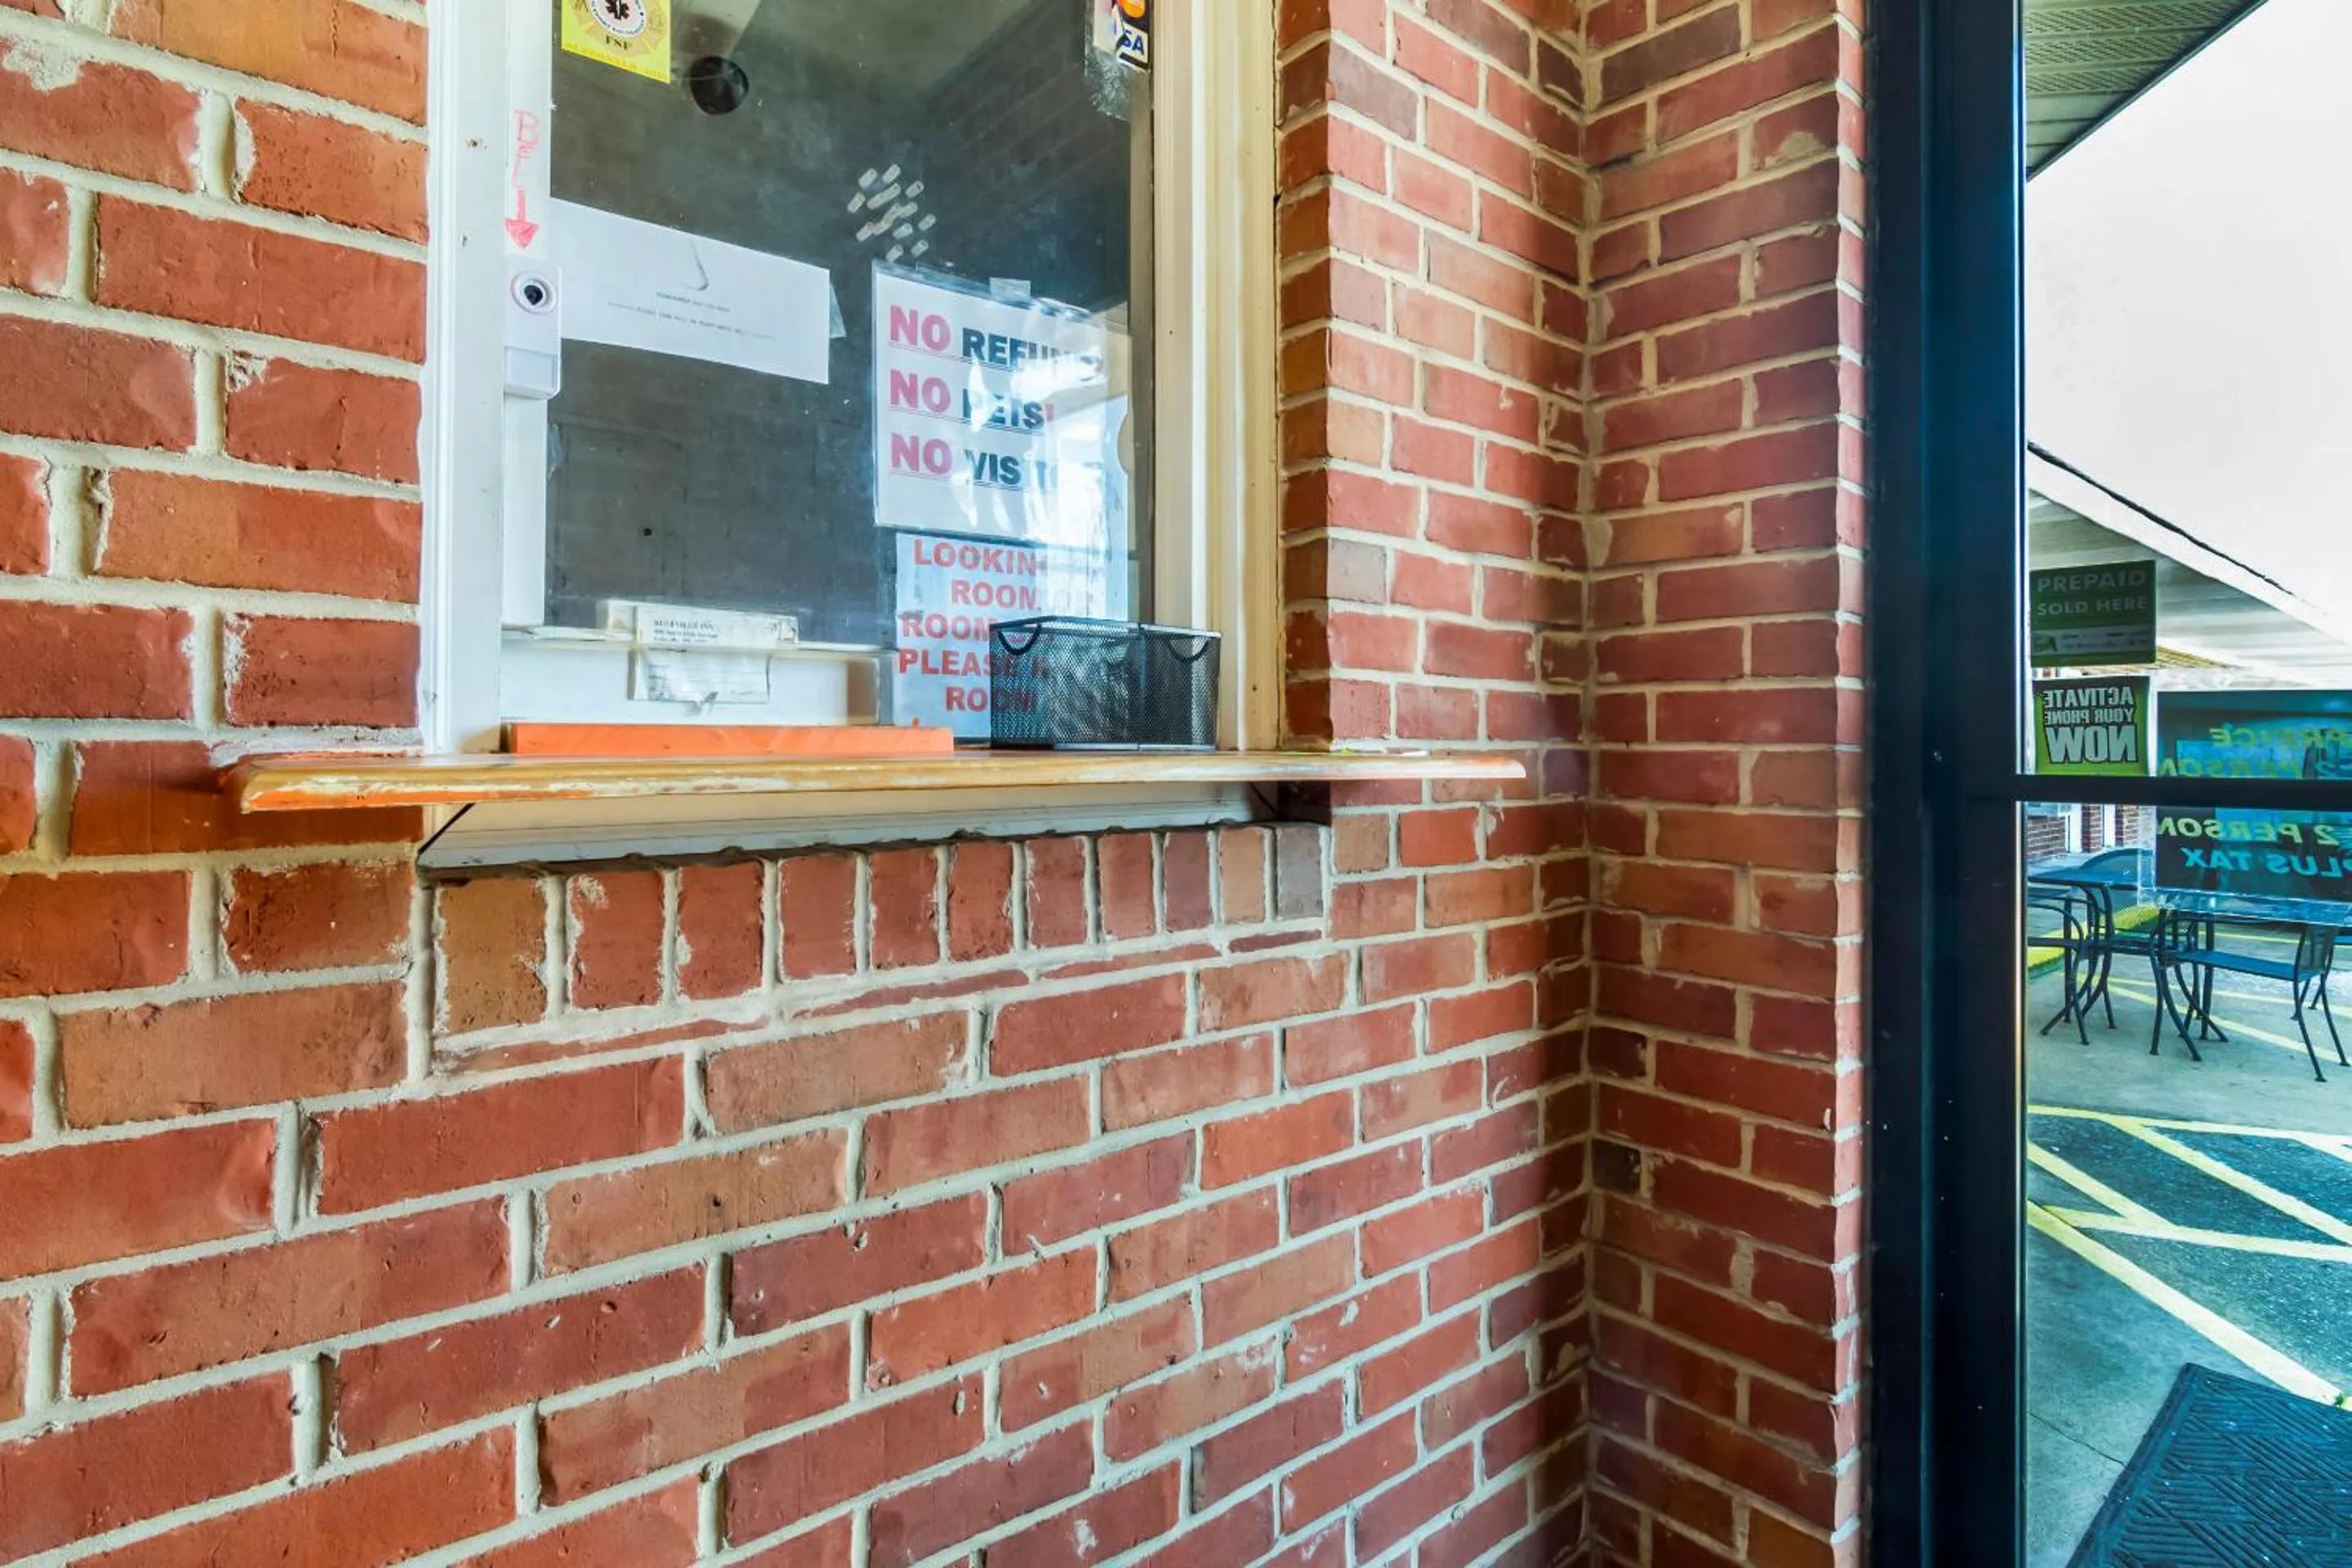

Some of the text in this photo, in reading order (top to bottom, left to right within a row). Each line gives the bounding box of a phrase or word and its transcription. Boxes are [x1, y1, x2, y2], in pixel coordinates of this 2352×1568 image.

[889, 305, 951, 352] NO
[889, 369, 951, 413] NO
[890, 433, 952, 475] NO
[913, 539, 1040, 577] LOOKIN
[2036, 571, 2146, 593] PREPAID
[2036, 596, 2147, 617] SOLD HERE
